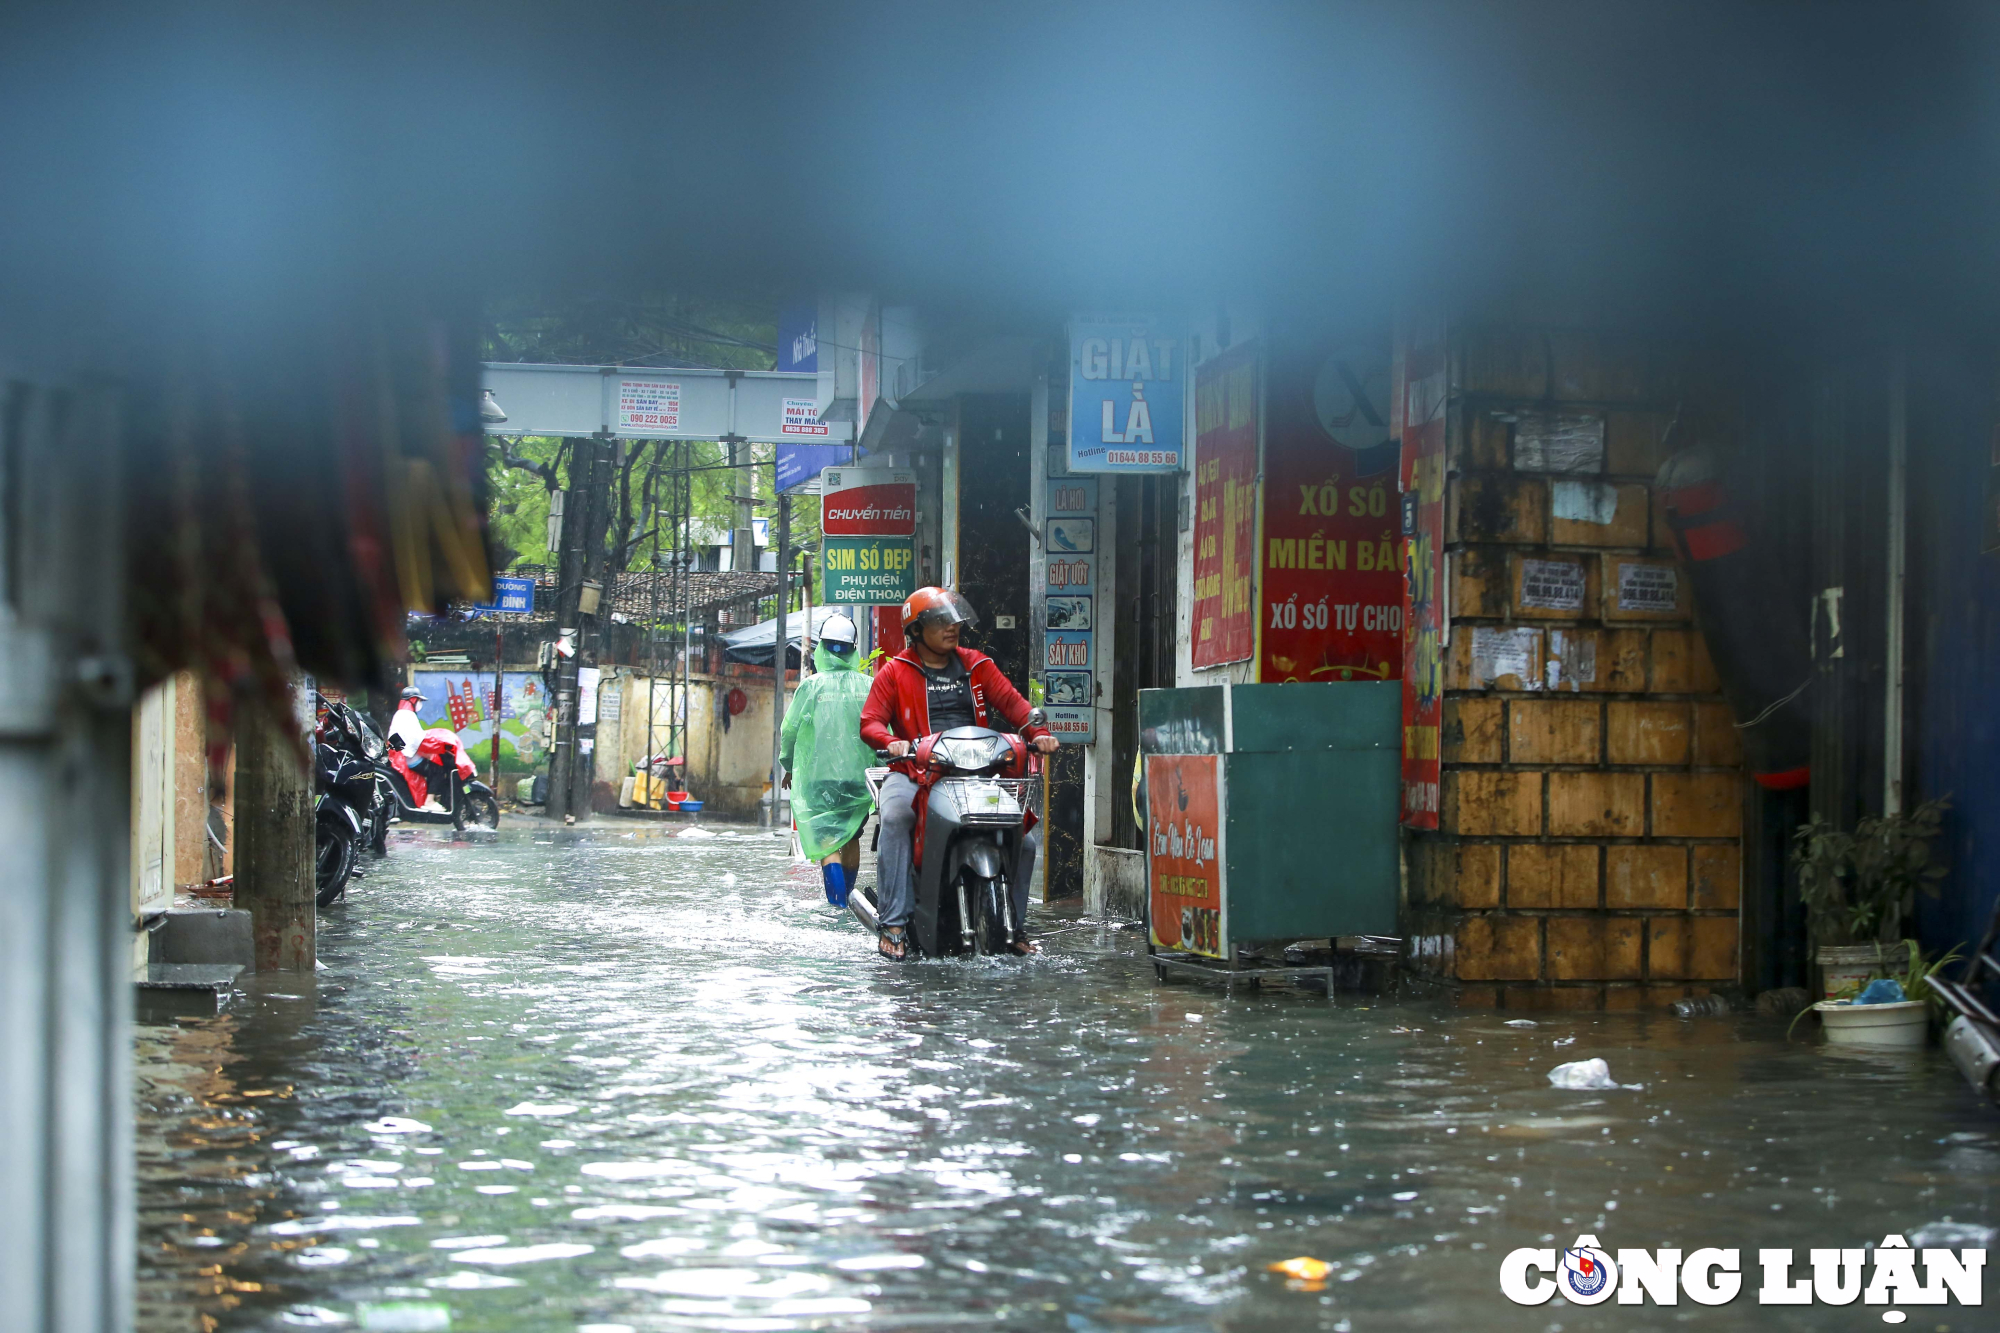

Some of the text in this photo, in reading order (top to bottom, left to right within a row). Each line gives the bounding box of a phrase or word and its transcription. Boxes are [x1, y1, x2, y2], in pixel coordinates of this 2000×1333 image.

[1081, 328, 1178, 390] GIẶT
[631, 414, 677, 425] 090 222 0025
[787, 408, 805, 416] MÁI
[1102, 391, 1155, 443] LÀ
[1078, 447, 1177, 464] Hotline 01644 88 55 66
[1056, 485, 1069, 511] LÀ
[1299, 474, 1340, 516] XỔ
[1348, 476, 1387, 517] SỐ
[827, 541, 912, 575] SIM SỐ ĐẸP
[1269, 529, 1347, 570] MIỀN
[841, 574, 900, 587] PHỤ KIỆN
[1049, 559, 1089, 590] GIẶT ƯỚT
[502, 594, 526, 609] ĐÌNH
[835, 588, 905, 601] ĐIỆN THOẠI
[1271, 593, 1403, 637] XỔ SỐ TỰ CHỌ
[1049, 636, 1088, 666] SẤY KHÔ
[1073, 722, 1080, 732] 55
[1081, 722, 1088, 732] 66
